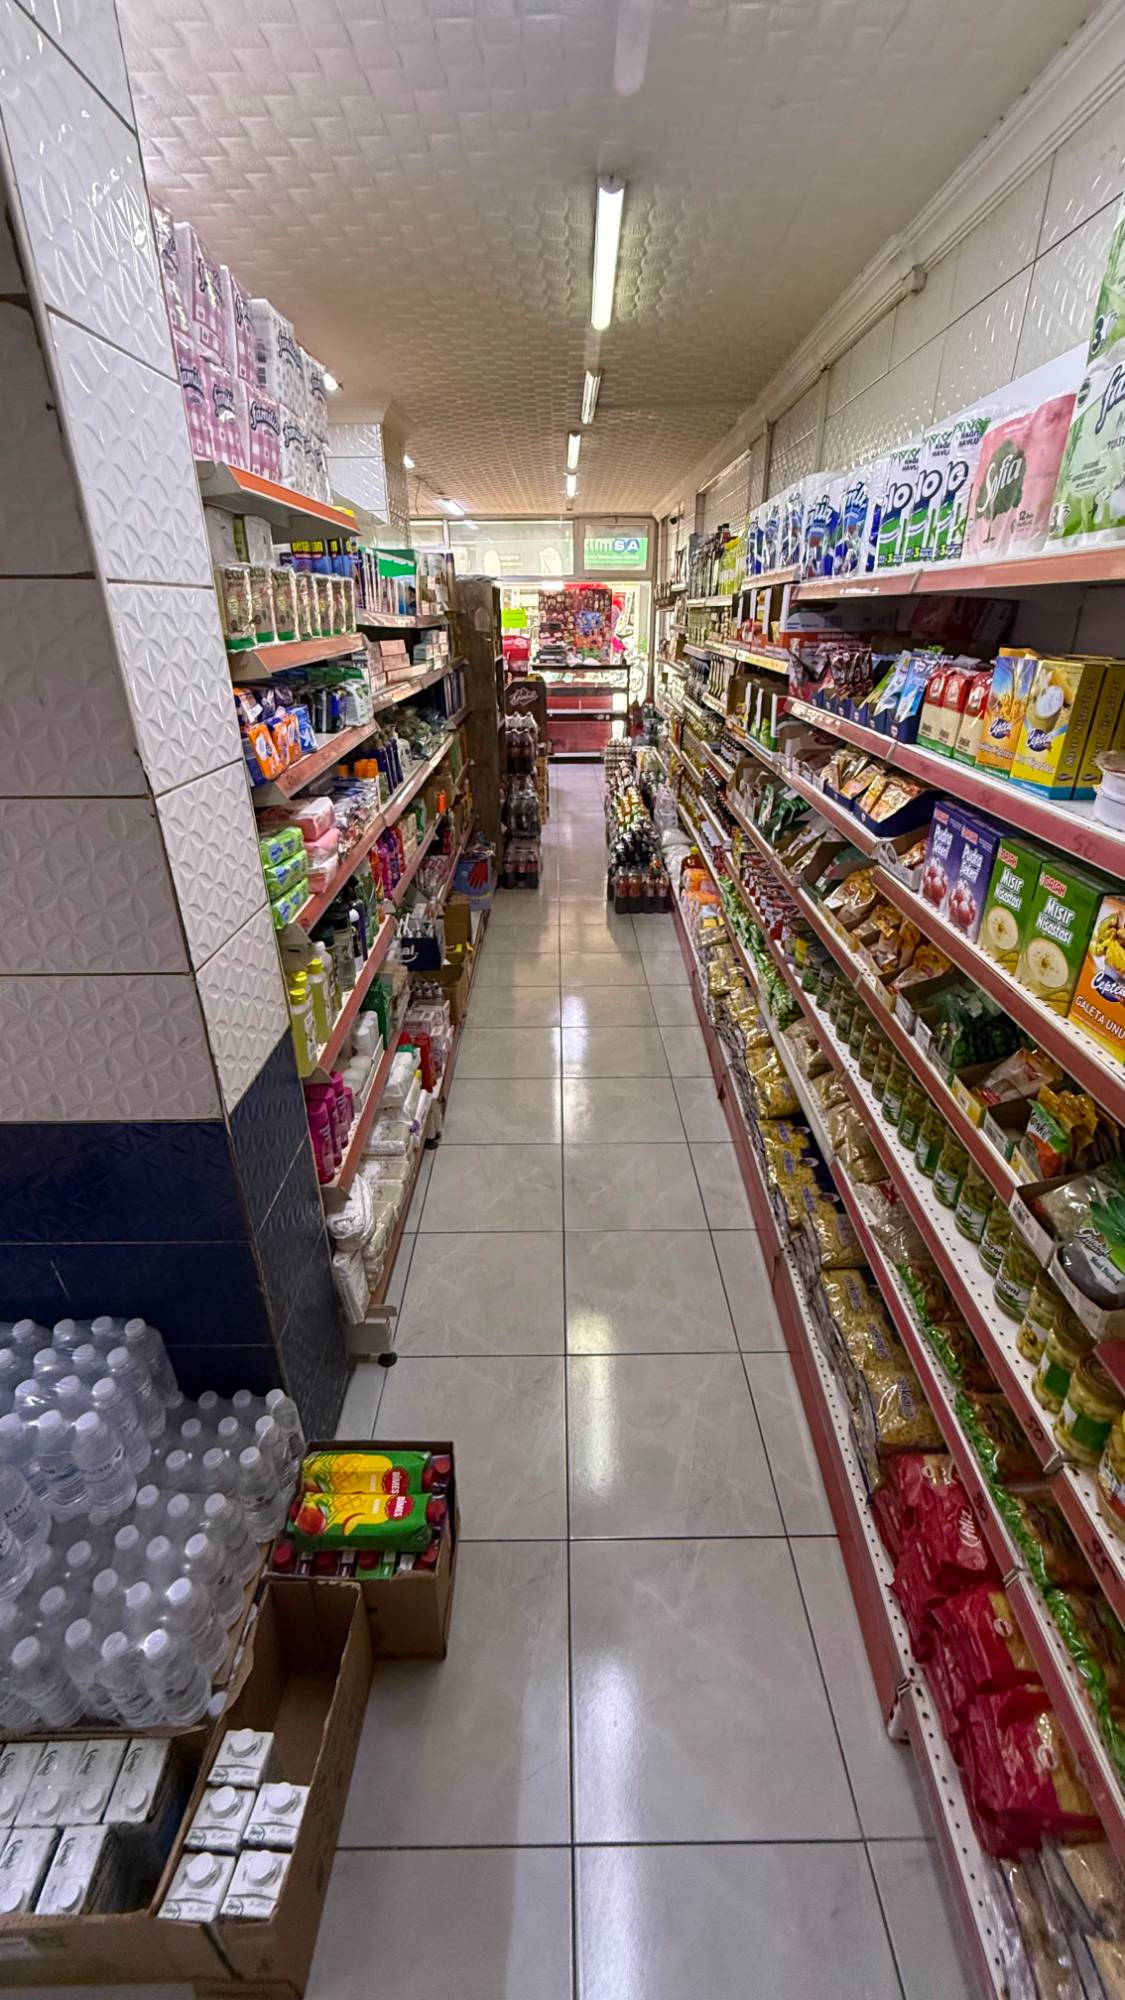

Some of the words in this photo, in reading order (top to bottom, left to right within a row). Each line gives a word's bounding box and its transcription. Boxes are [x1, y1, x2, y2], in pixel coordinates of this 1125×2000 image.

[977, 455, 1022, 512] Sofia
[1075, 996, 1106, 1026] GALETA
[1106, 1019, 1125, 1039] UNU
